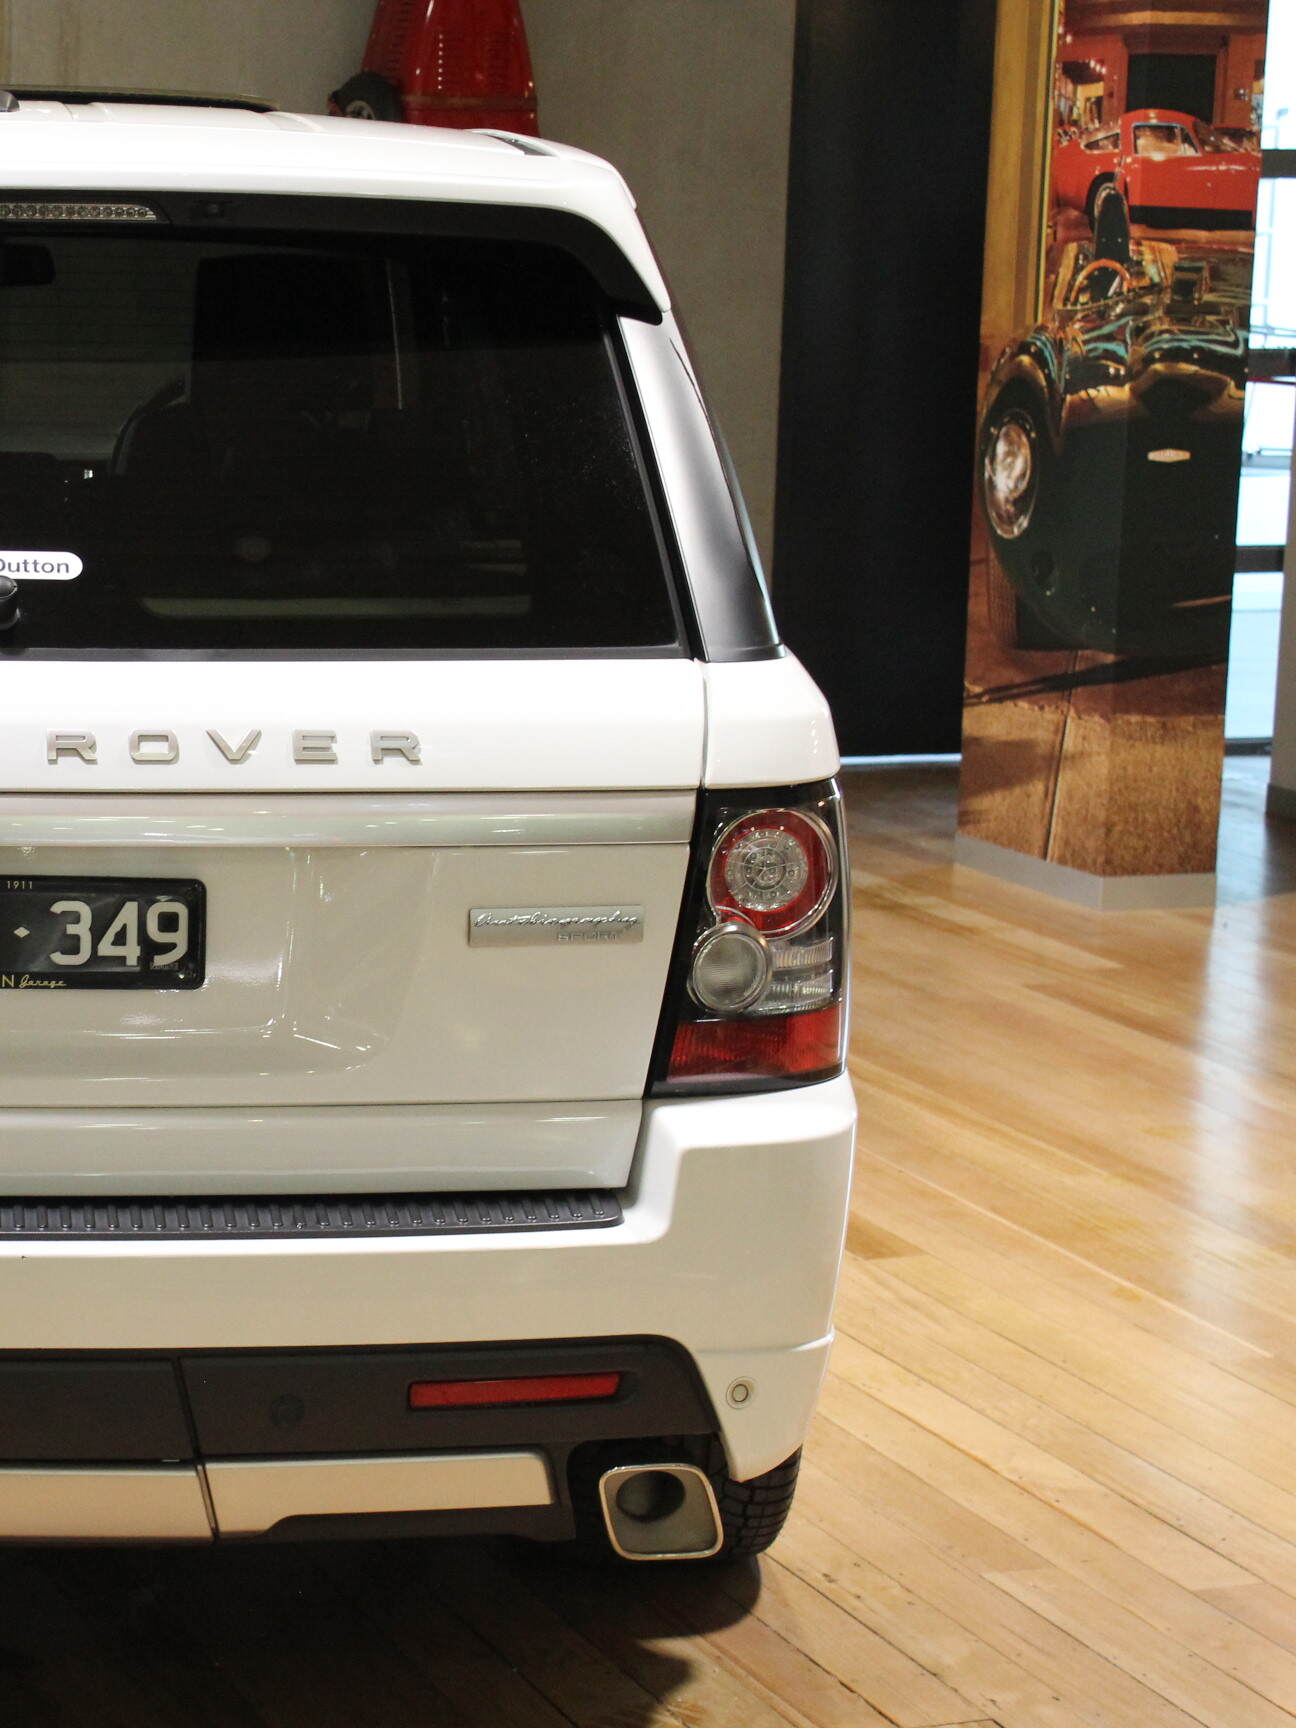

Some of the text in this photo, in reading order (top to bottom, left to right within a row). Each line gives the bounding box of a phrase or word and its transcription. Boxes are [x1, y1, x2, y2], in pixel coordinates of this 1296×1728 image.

[46, 728, 424, 765] ROVER
[7, 880, 33, 890] 1911
[49, 899, 190, 967] 349
[18, 973, 67, 989] Garage
